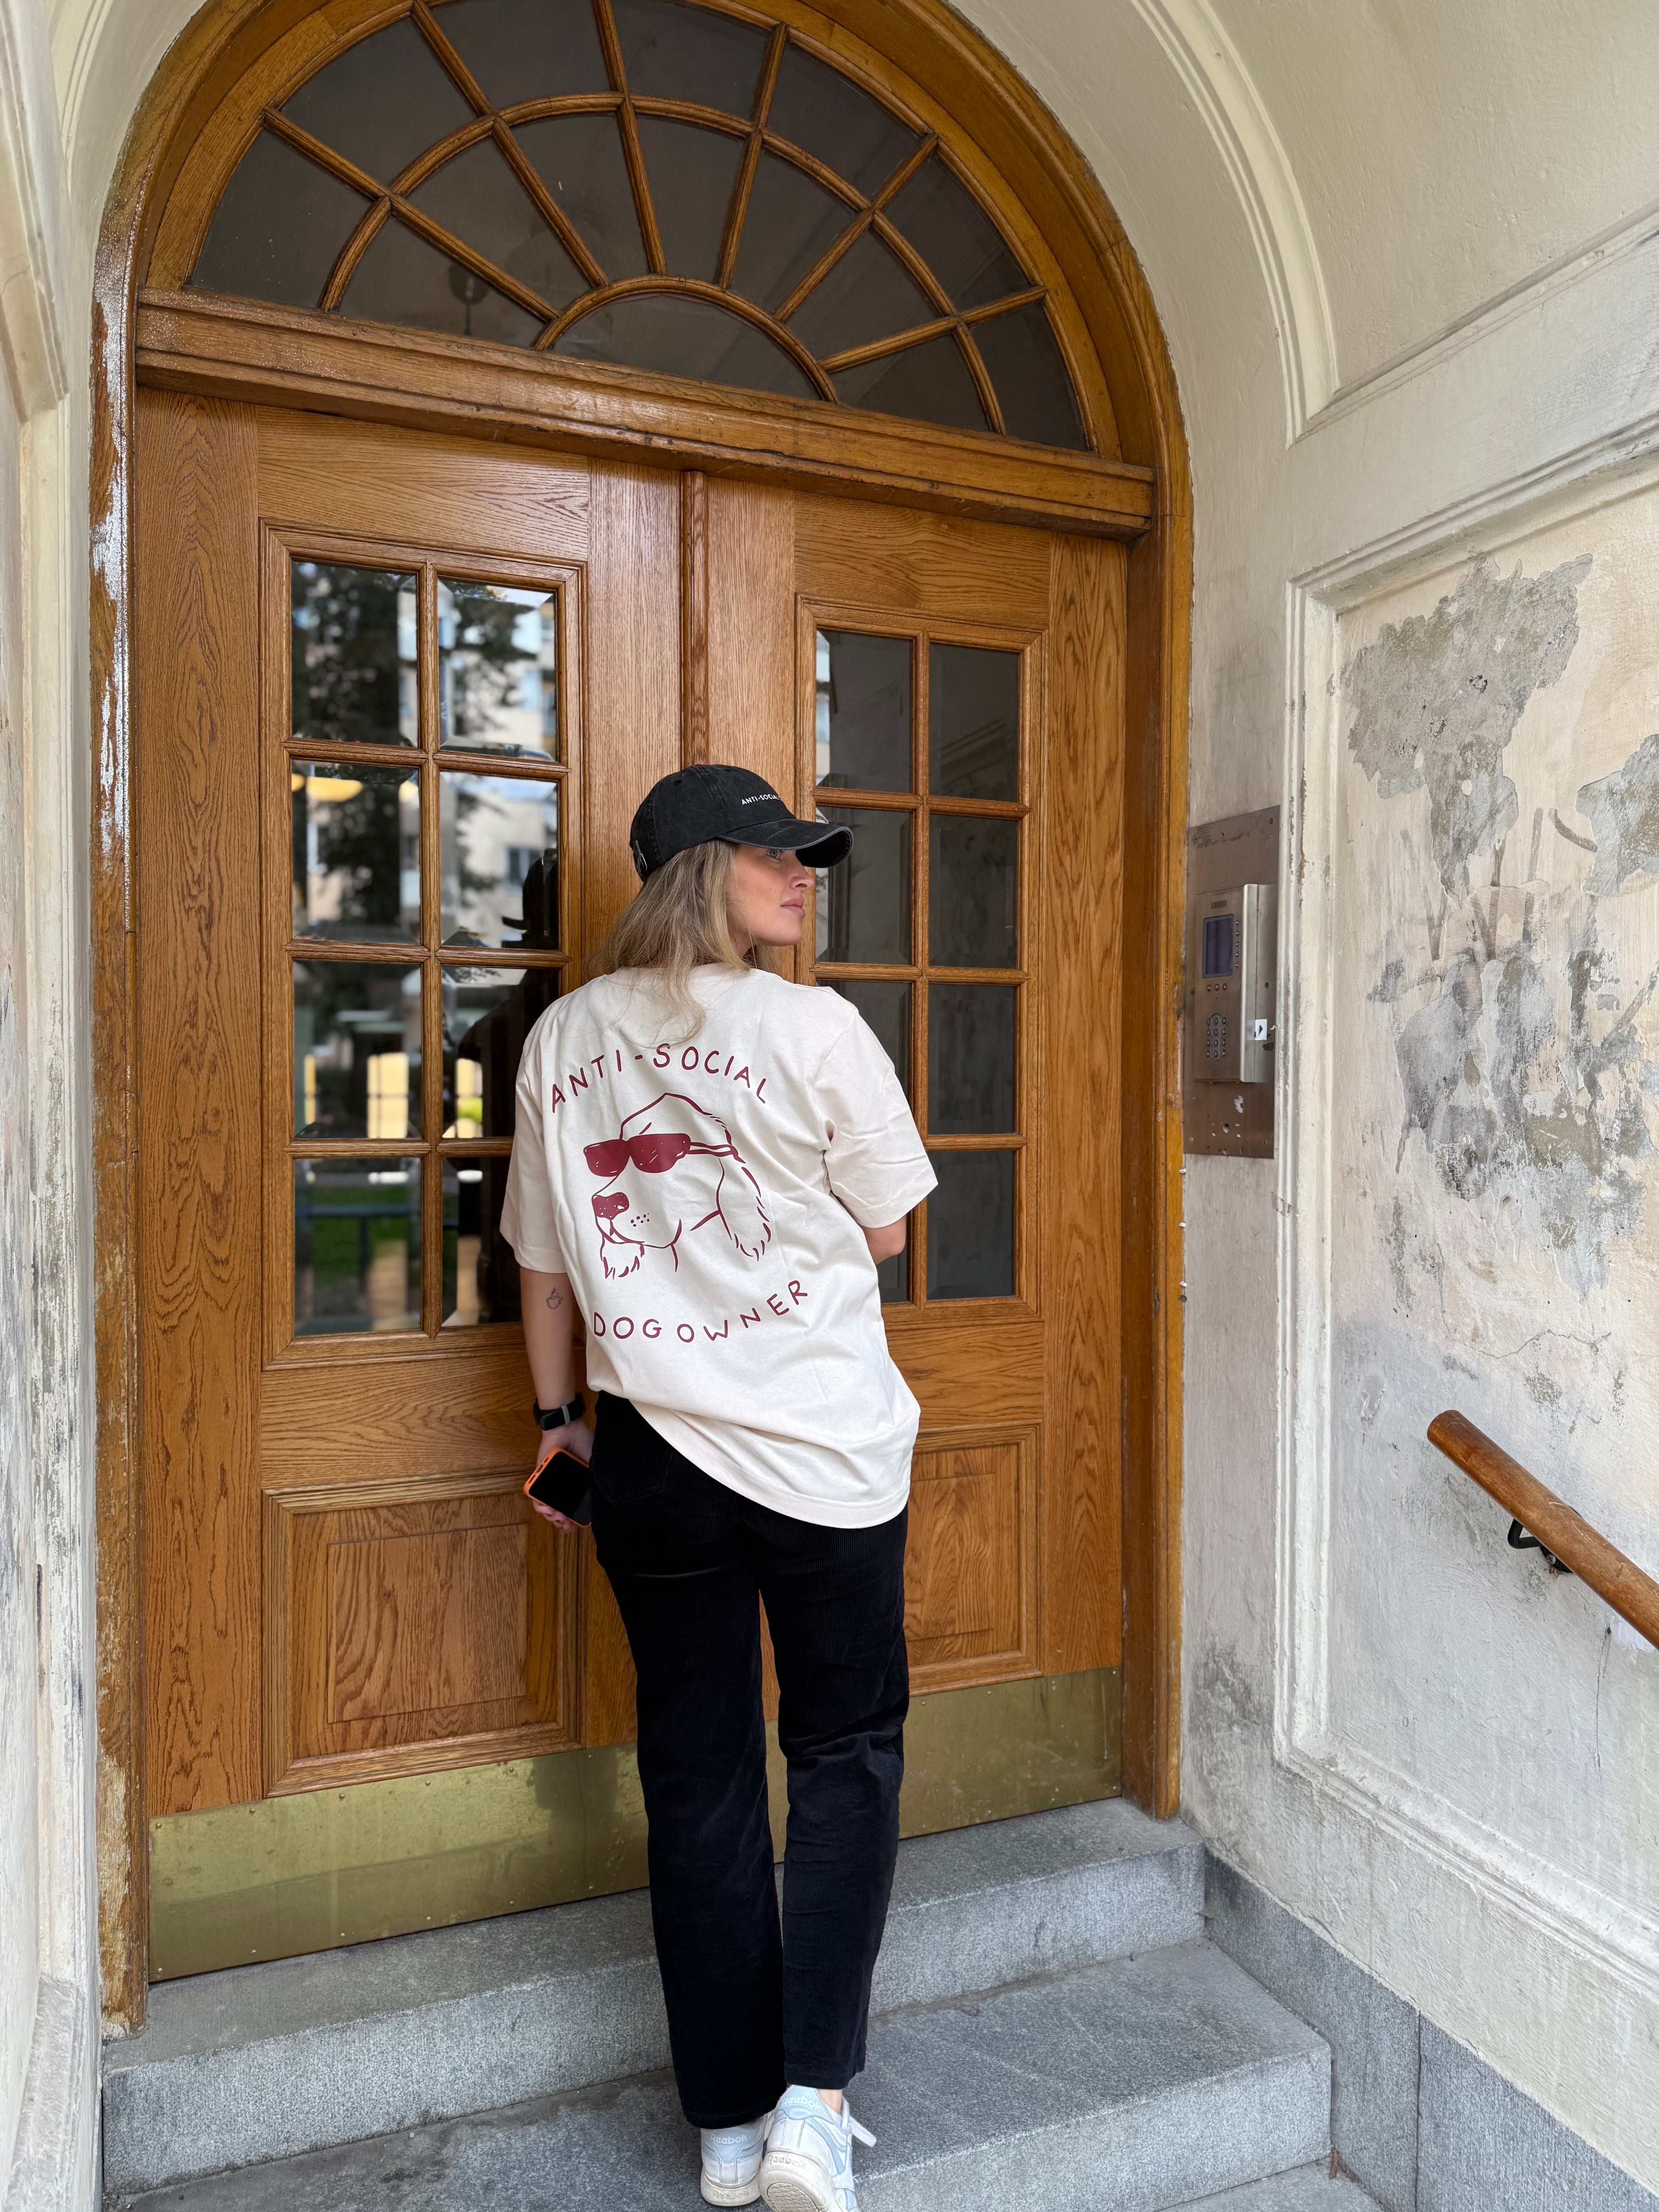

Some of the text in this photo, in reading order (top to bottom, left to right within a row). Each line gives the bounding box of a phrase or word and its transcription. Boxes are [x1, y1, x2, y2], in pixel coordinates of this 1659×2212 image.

[552, 1043, 766, 1113] ANTI-SOCIAL
[782, 2095, 822, 2112] Reebok
[711, 2133, 747, 2144] Reebok
[768, 2155, 806, 2169] Reebok
